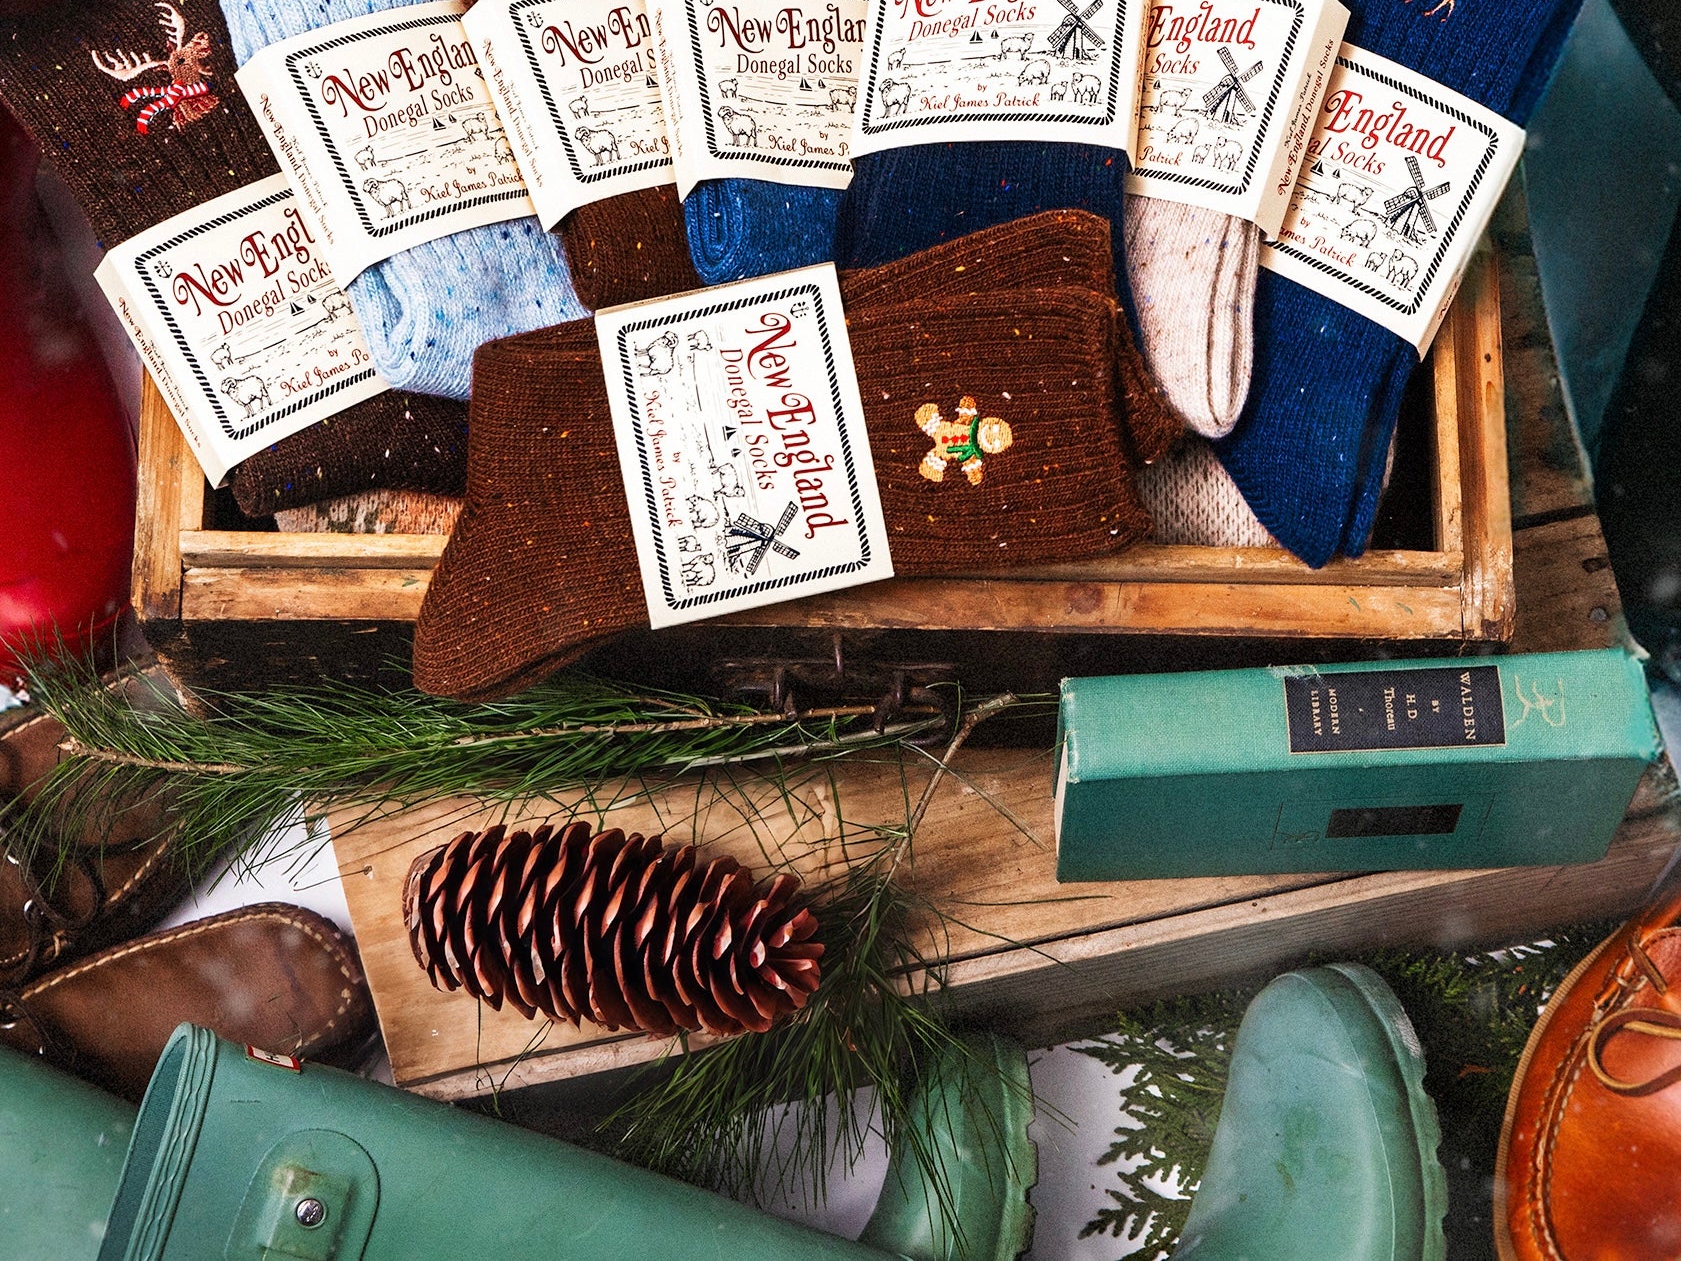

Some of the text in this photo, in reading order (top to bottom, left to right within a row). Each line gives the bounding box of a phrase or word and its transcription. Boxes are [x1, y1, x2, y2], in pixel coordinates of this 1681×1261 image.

[706, 6, 772, 54] New
[775, 3, 867, 54] Englan
[907, 1, 1037, 42] Donegal Socks
[1147, 0, 1261, 54] England
[482, 37, 496, 67] New
[541, 20, 608, 67] New
[321, 33, 479, 118] New Englan
[580, 52, 644, 89] Donegal
[736, 53, 853, 80] Donegal Socks
[1150, 52, 1200, 75] Socks
[919, 92, 1041, 112] Kiel James Patrick
[977, 83, 988, 92] by
[259, 93, 275, 123] New
[363, 82, 475, 139] Donegal Socks
[1277, 166, 1292, 196] New
[1305, 69, 1324, 113] Donegal
[1319, 38, 1334, 69] Socks
[629, 137, 660, 156] Kiel
[768, 134, 797, 152] Kiel
[798, 140, 835, 156] James
[819, 130, 829, 140] by
[1323, 89, 1457, 169] England
[466, 166, 476, 176] by
[1138, 145, 1183, 166] Patrick
[1330, 141, 1387, 176] Socks
[420, 167, 525, 203] Kiel James Patrick
[1300, 217, 1310, 228] by
[172, 208, 316, 317] New Engl
[1279, 226, 1358, 268] ames Patrick
[118, 296, 135, 326] New
[217, 280, 286, 335] Donegal
[327, 348, 339, 358] by
[280, 361, 351, 397] Kiel James
[719, 347, 776, 491] Donegal Socks
[744, 311, 849, 541] New England
[642, 389, 685, 530] Kiel James Patrick
[672, 450, 681, 465] by
[1310, 689, 1323, 736] LIBRARY
[1328, 687, 1341, 735] MODERN
[1383, 686, 1396, 731] Thoreau
[1431, 699, 1440, 713] BY
[1460, 671, 1476, 740] WALDEN
